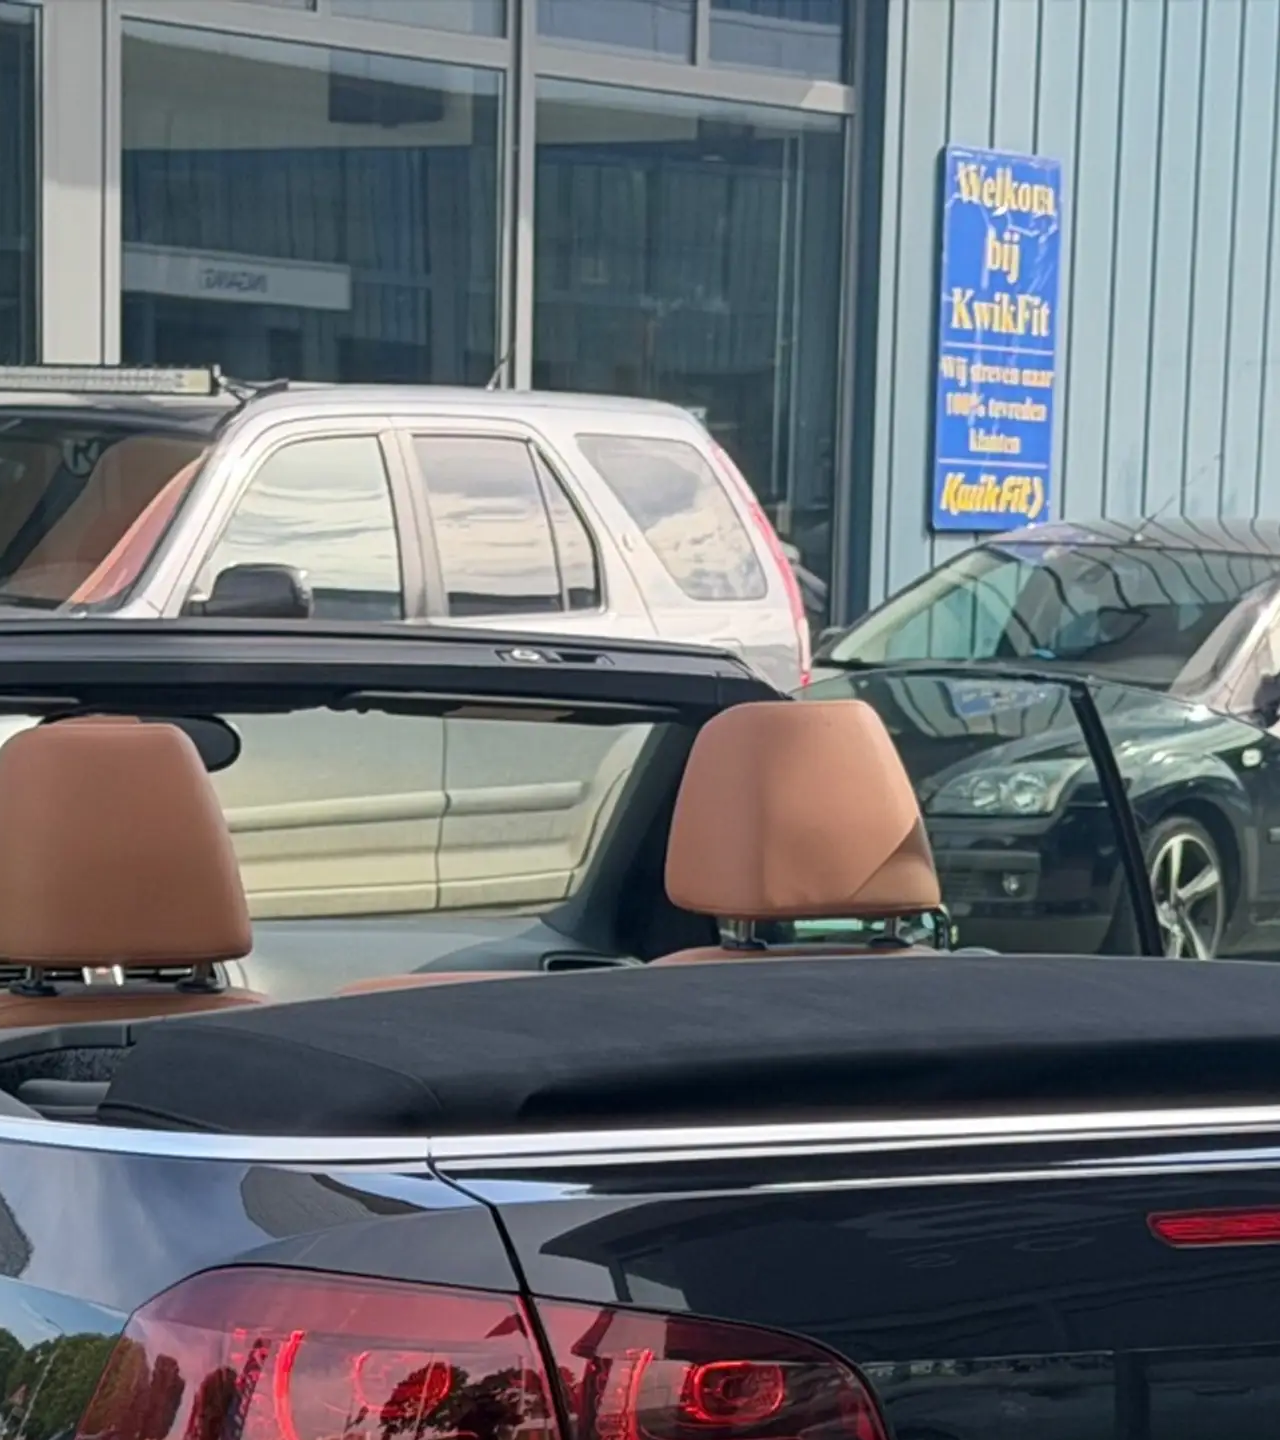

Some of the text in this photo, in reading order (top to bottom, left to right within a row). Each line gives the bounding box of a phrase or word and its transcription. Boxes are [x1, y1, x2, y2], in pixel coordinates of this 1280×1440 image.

[956, 162, 1057, 216] Welkom
[987, 226, 1019, 284] bij
[950, 287, 1051, 337] KwikFit
